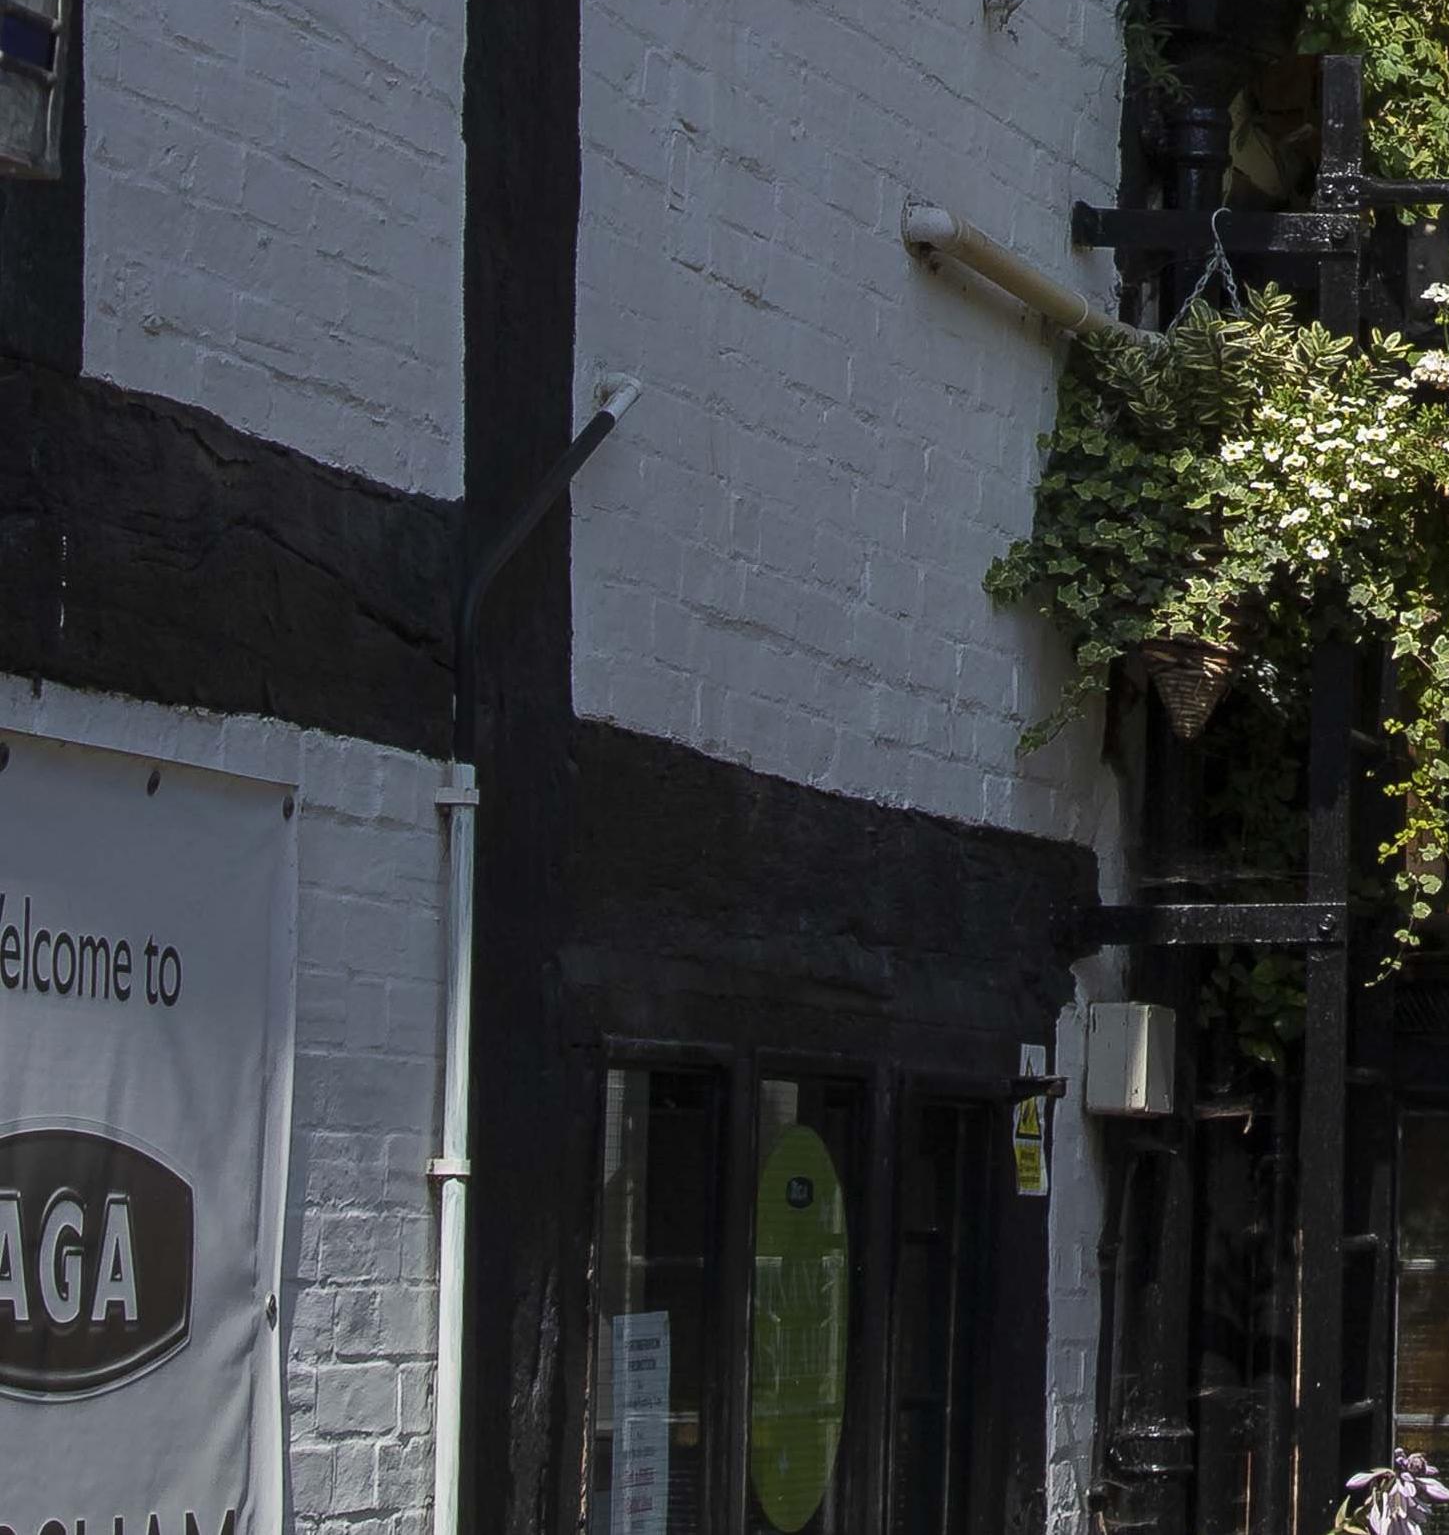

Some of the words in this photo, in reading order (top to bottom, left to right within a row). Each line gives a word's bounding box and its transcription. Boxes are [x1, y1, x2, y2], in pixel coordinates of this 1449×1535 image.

[0, 893, 132, 1002] elcome
[144, 934, 182, 1007] to
[0, 1192, 138, 1323] AGA
